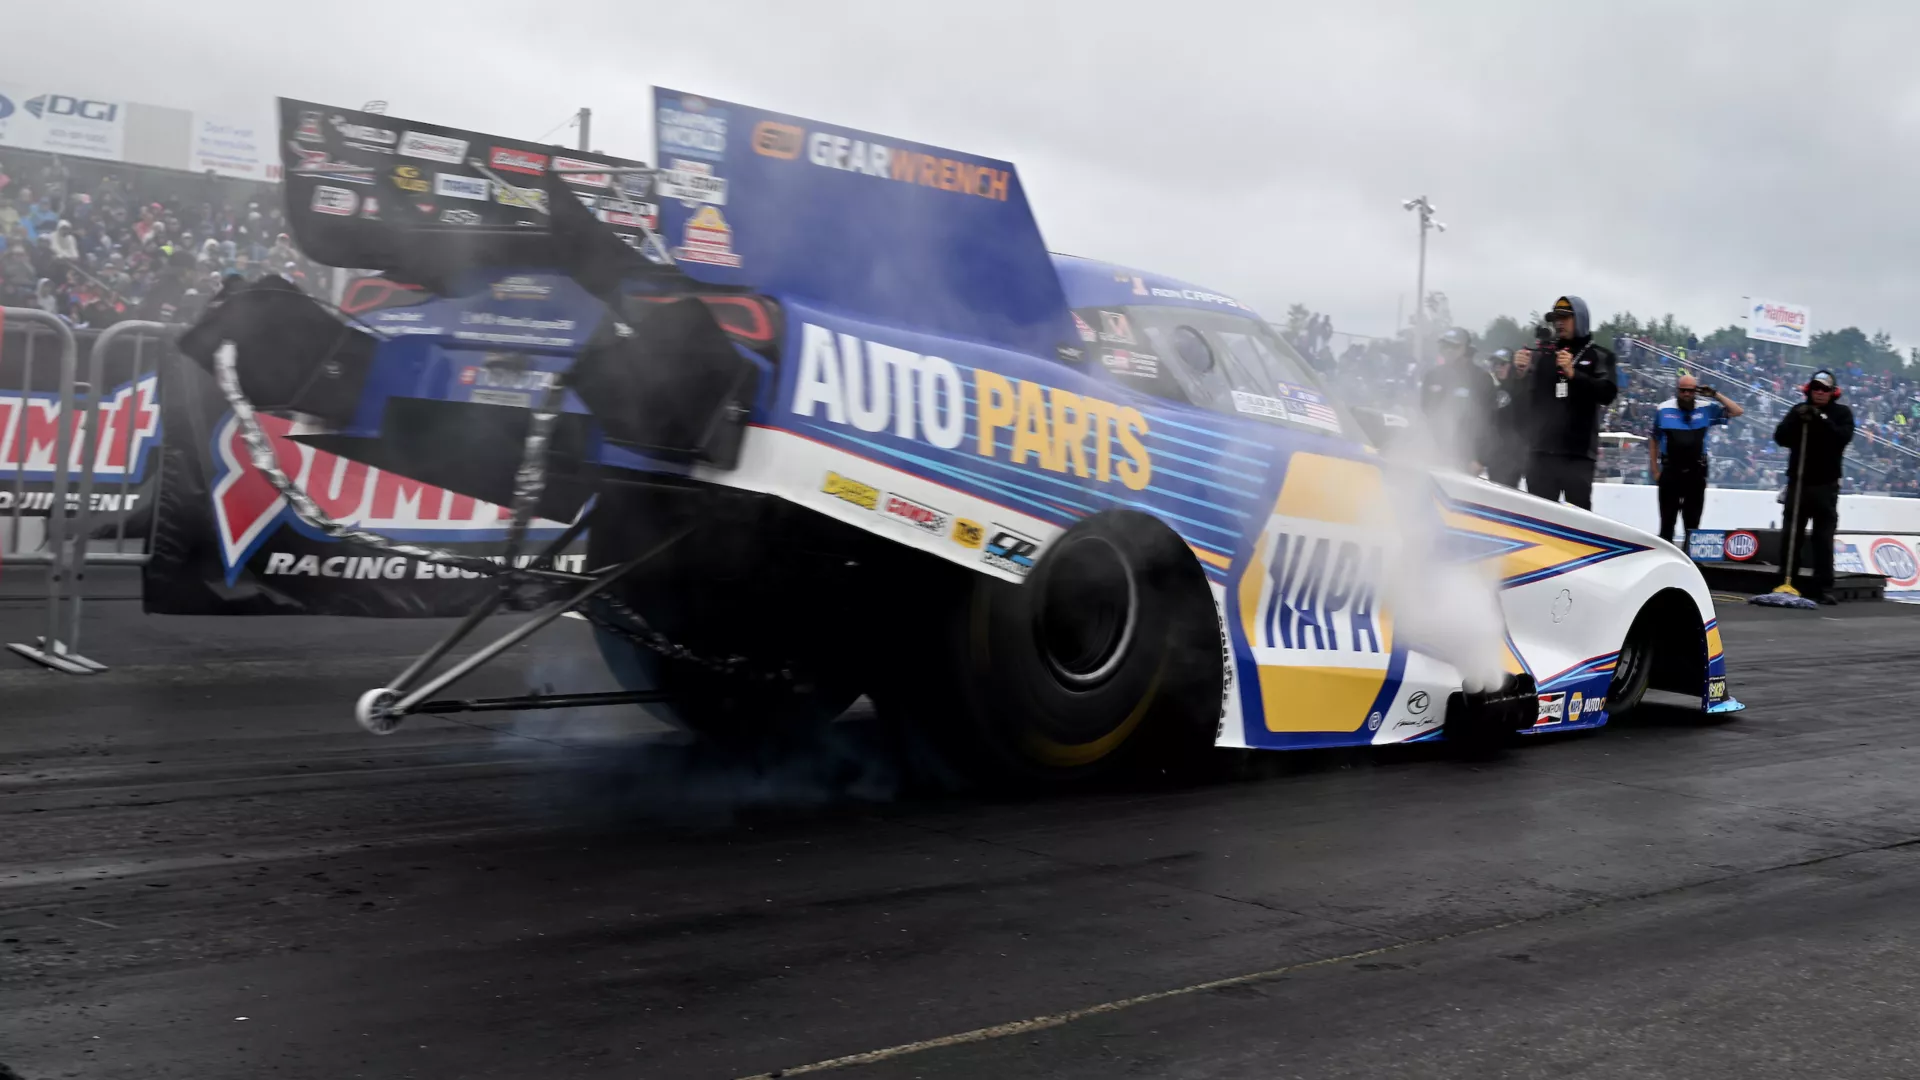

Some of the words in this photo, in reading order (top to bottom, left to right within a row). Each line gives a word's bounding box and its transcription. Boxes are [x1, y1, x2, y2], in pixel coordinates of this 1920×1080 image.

[47, 94, 118, 122] DGI
[808, 131, 1010, 202] GEARWRENCH
[1181, 289, 1238, 308] CAPPS
[791, 322, 966, 450] AUTO
[974, 368, 1152, 491] PARTS
[1690, 533, 1725, 545] CAMPING
[1690, 544, 1723, 558] WORLD
[264, 552, 407, 580] RACING
[1263, 531, 1382, 653] NAPA
